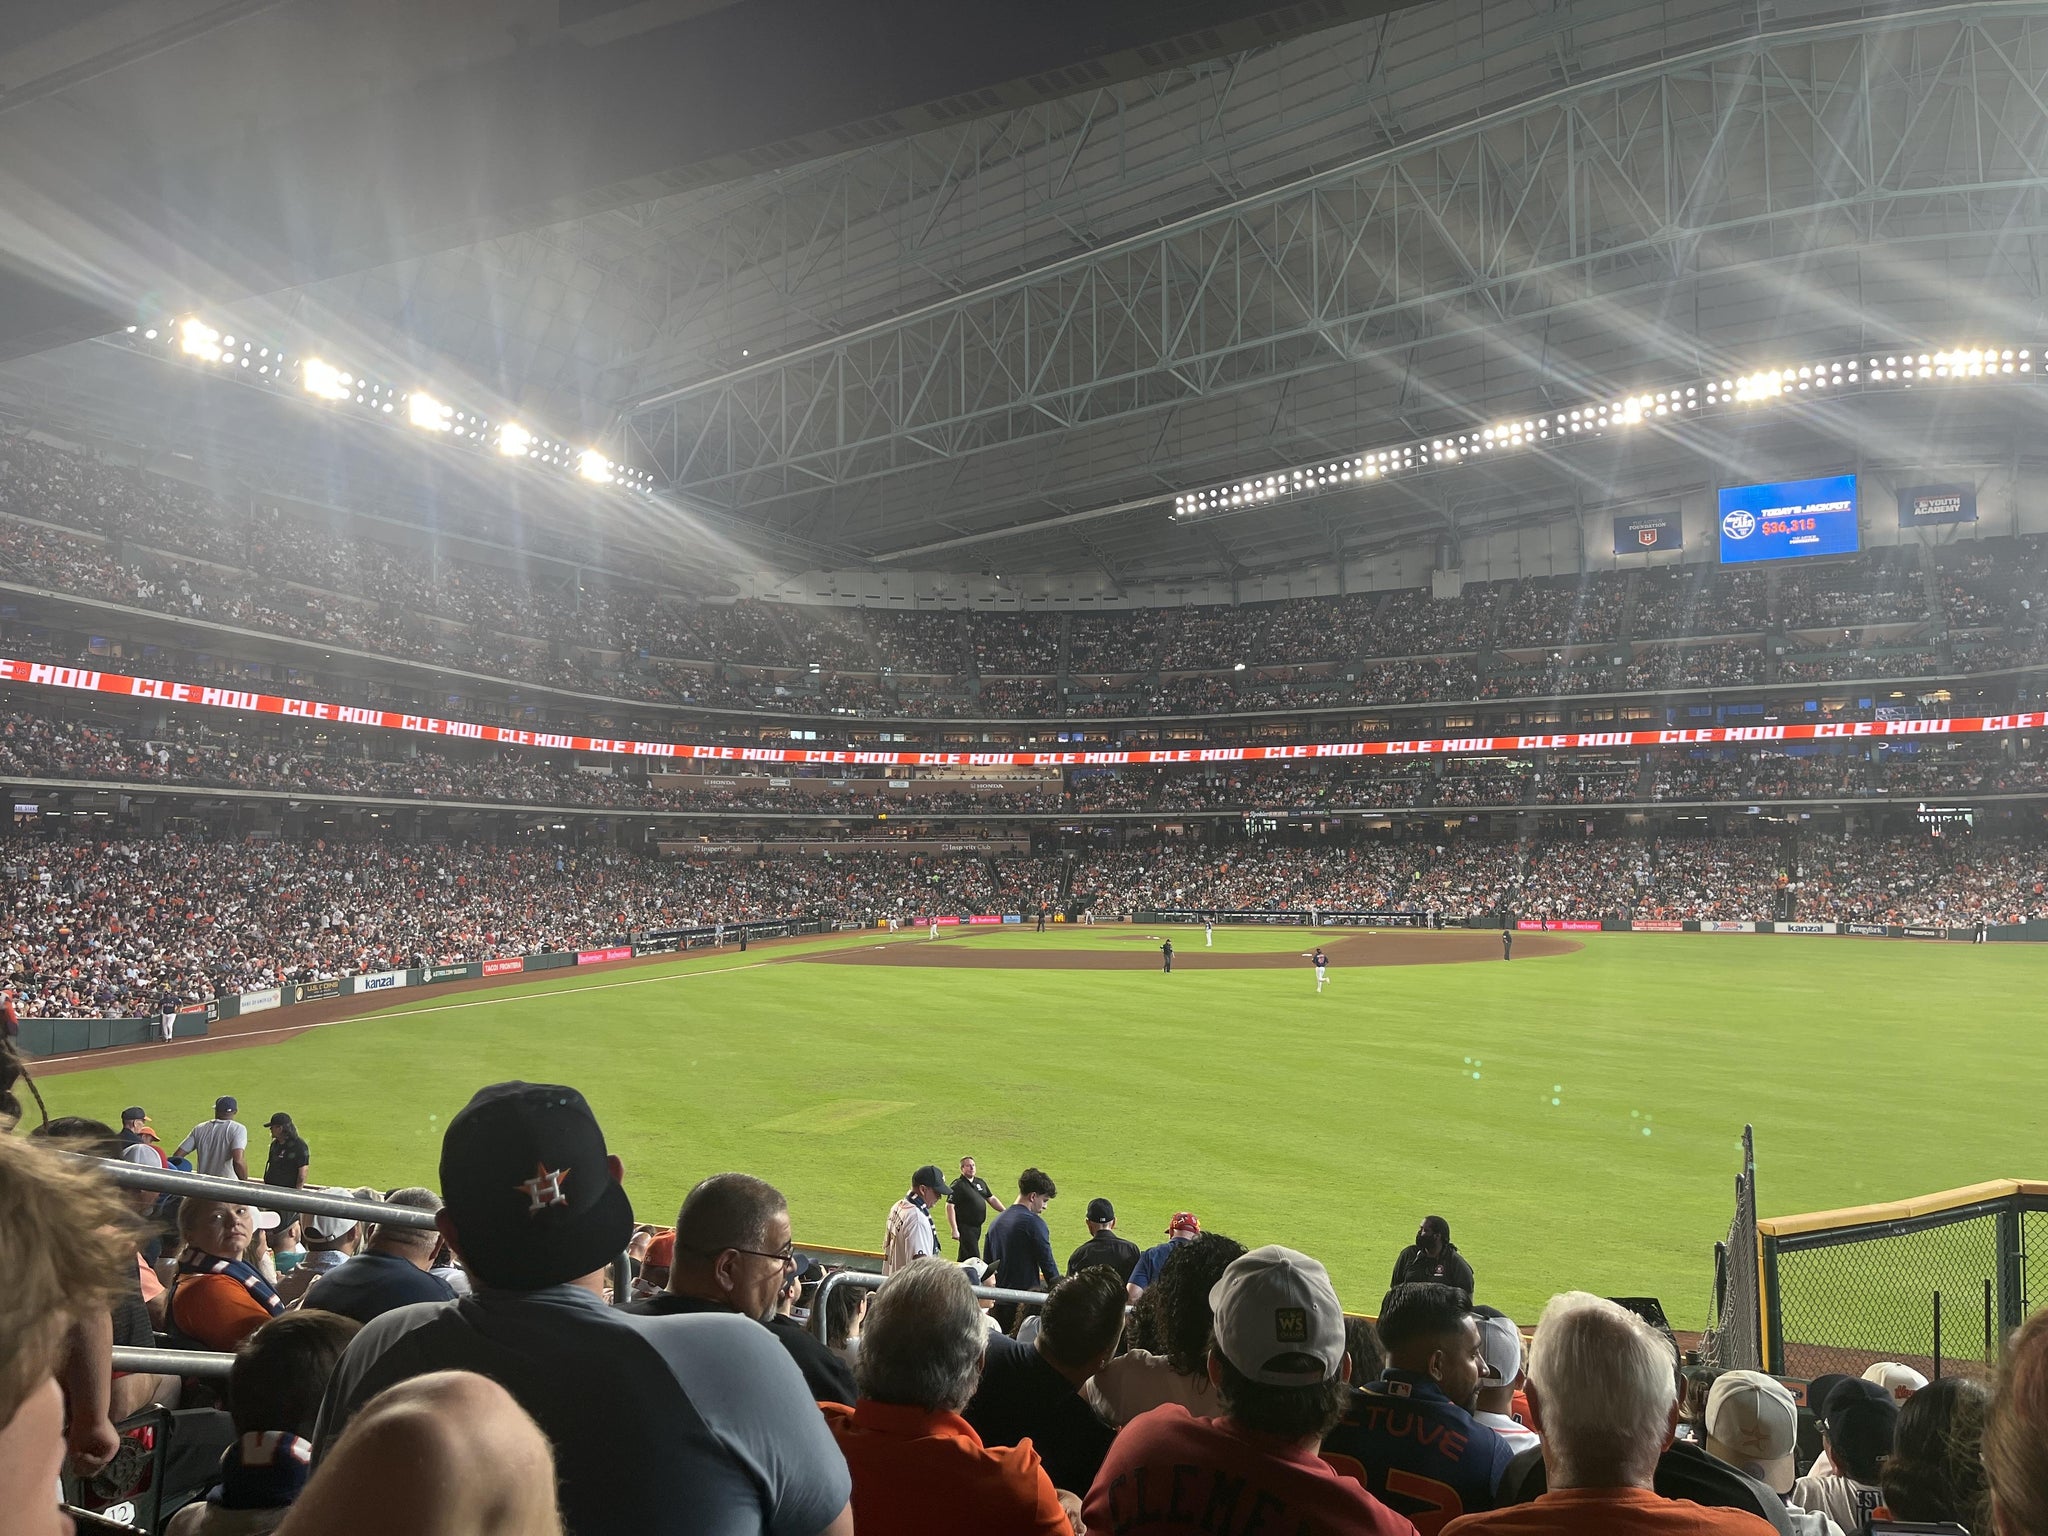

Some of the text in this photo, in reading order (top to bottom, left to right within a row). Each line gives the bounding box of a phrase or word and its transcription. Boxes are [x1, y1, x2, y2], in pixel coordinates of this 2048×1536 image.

[1802, 501, 1851, 513] JACKPOT
[1914, 505, 1960, 515] ACADEMY
[1929, 498, 1960, 507] YOUTH
[1762, 518, 1815, 536] $36,315
[14, 666, 26, 675] VS
[29, 664, 100, 690] HOU
[132, 678, 190, 701] CLE
[202, 687, 258, 710] HOU
[283, 699, 328, 719] CLE
[338, 706, 382, 726] HOU
[402, 715, 482, 738] CLE HOU
[1814, 722, 1871, 737] CLE
[1886, 719, 1950, 734] HOU
[1982, 714, 2031, 731] CLE
[498, 728, 572, 748] CLE HOU
[1518, 735, 1566, 748] CLE
[1578, 732, 1632, 746] HOU
[1659, 729, 1712, 743] CLE
[1725, 726, 1784, 740] HOU
[590, 739, 674, 756] CLE HOU
[694, 746, 784, 761] CLE HOU
[1265, 744, 1363, 758] CLE HOU
[1387, 738, 1493, 753] CLE HOU
[806, 751, 898, 763] CLE HOU
[920, 754, 1013, 764] CLE HOU
[1034, 752, 1128, 764] CLE HOU
[1150, 749, 1243, 762] CLE HOU
[1520, 921, 1599, 930] Budwer Budweiser
[579, 949, 631, 962] Budweiser Budweiser
[1343, 1405, 1468, 1462] TUVE
[1108, 1463, 1312, 1536] CLEME
[111, 1505, 129, 1522] 12
